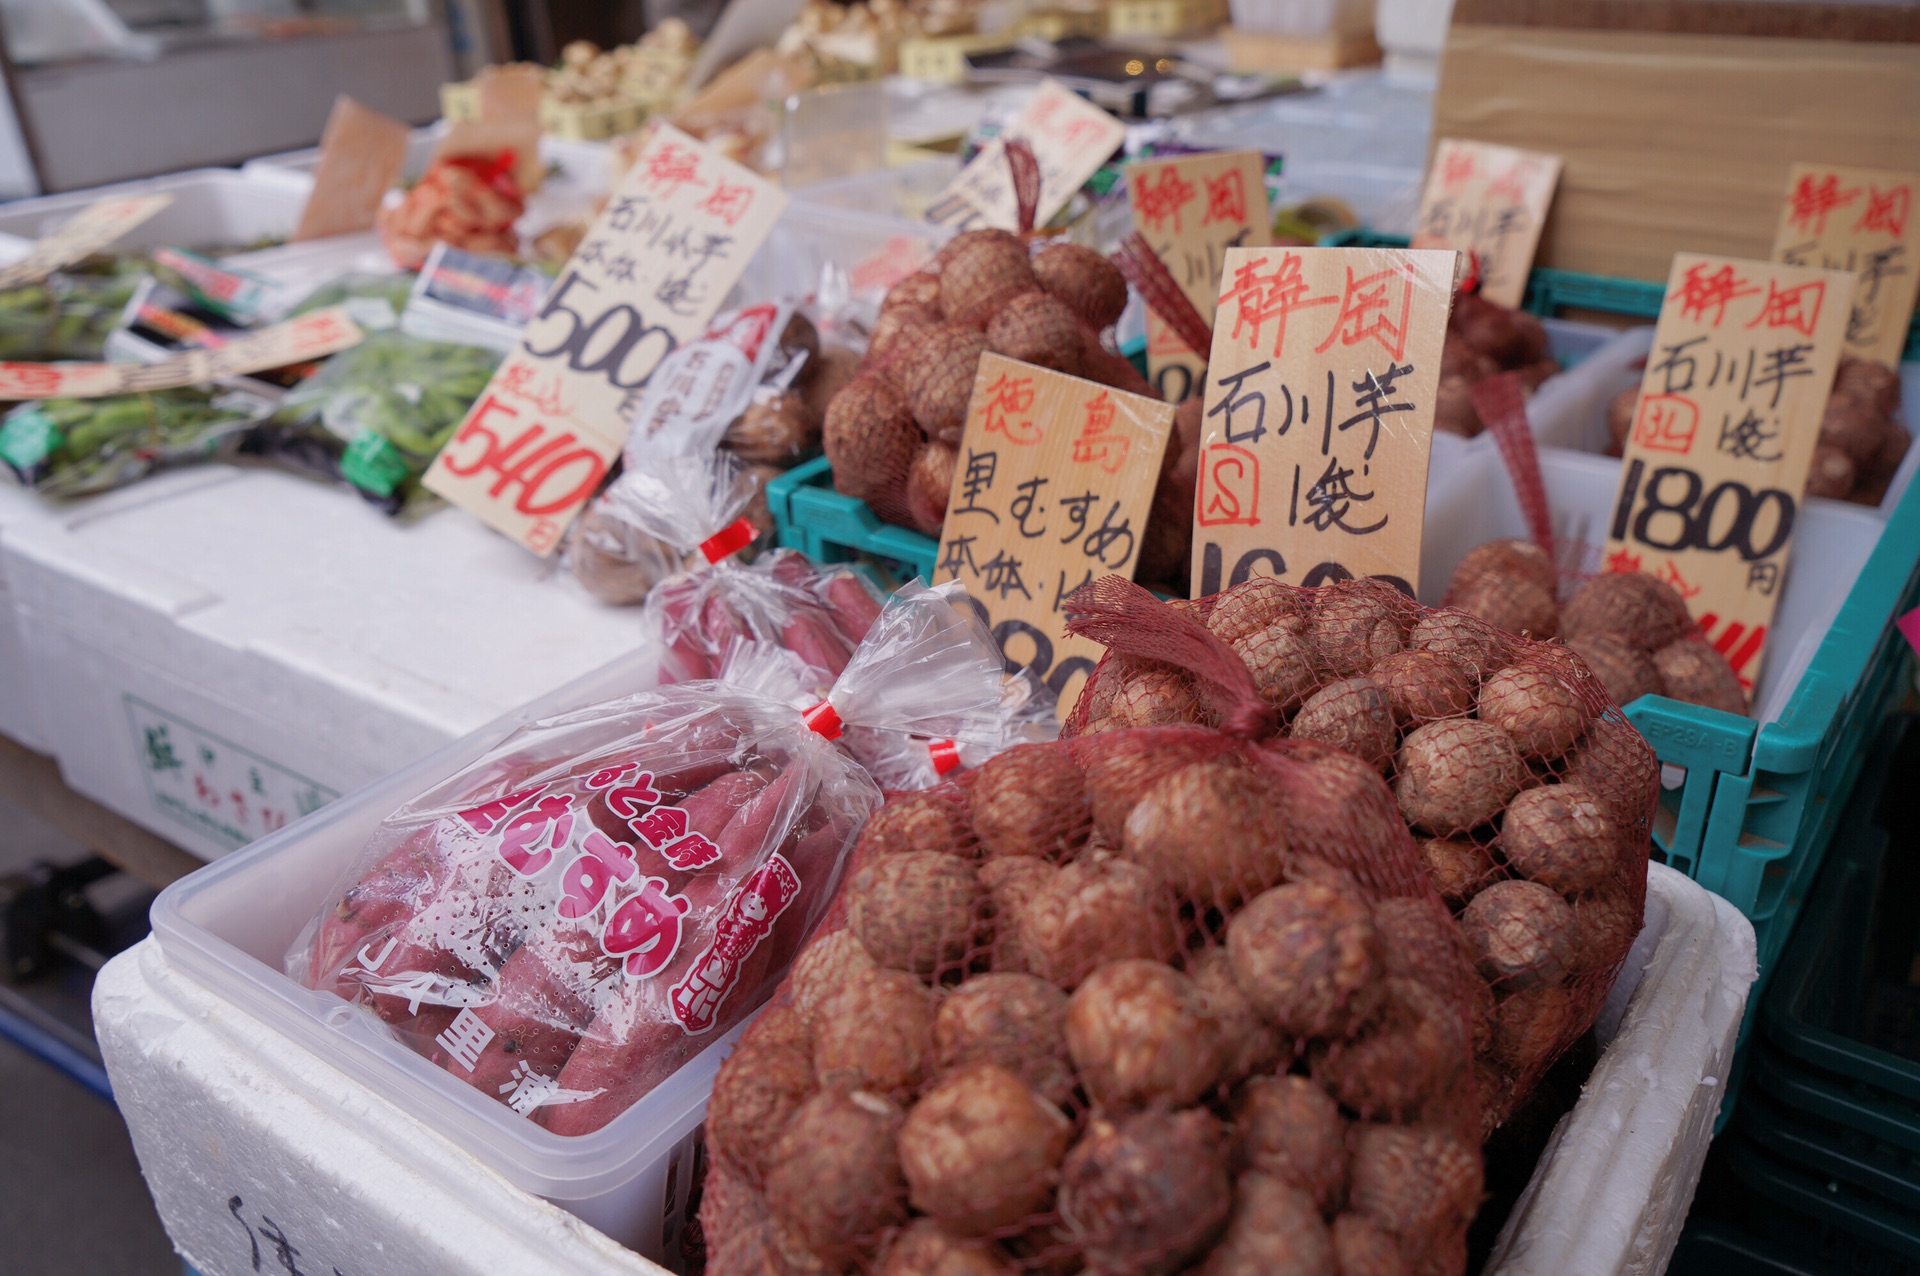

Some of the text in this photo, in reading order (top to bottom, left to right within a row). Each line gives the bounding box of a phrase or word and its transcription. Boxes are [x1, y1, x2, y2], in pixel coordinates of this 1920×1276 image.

[1134, 164, 1248, 234] 静岡
[522, 270, 678, 389] 500
[1218, 251, 1414, 361] 静岡
[1666, 262, 1826, 336] 静岡
[980, 372, 1131, 474] 徳島
[1207, 361, 1416, 460] 石川芋
[1653, 336, 1815, 408] 石川芋
[442, 394, 607, 516] 540
[953, 448, 1135, 569] 里むすめ
[1611, 458, 1796, 562] 1800
[1746, 562, 1779, 596] 円
